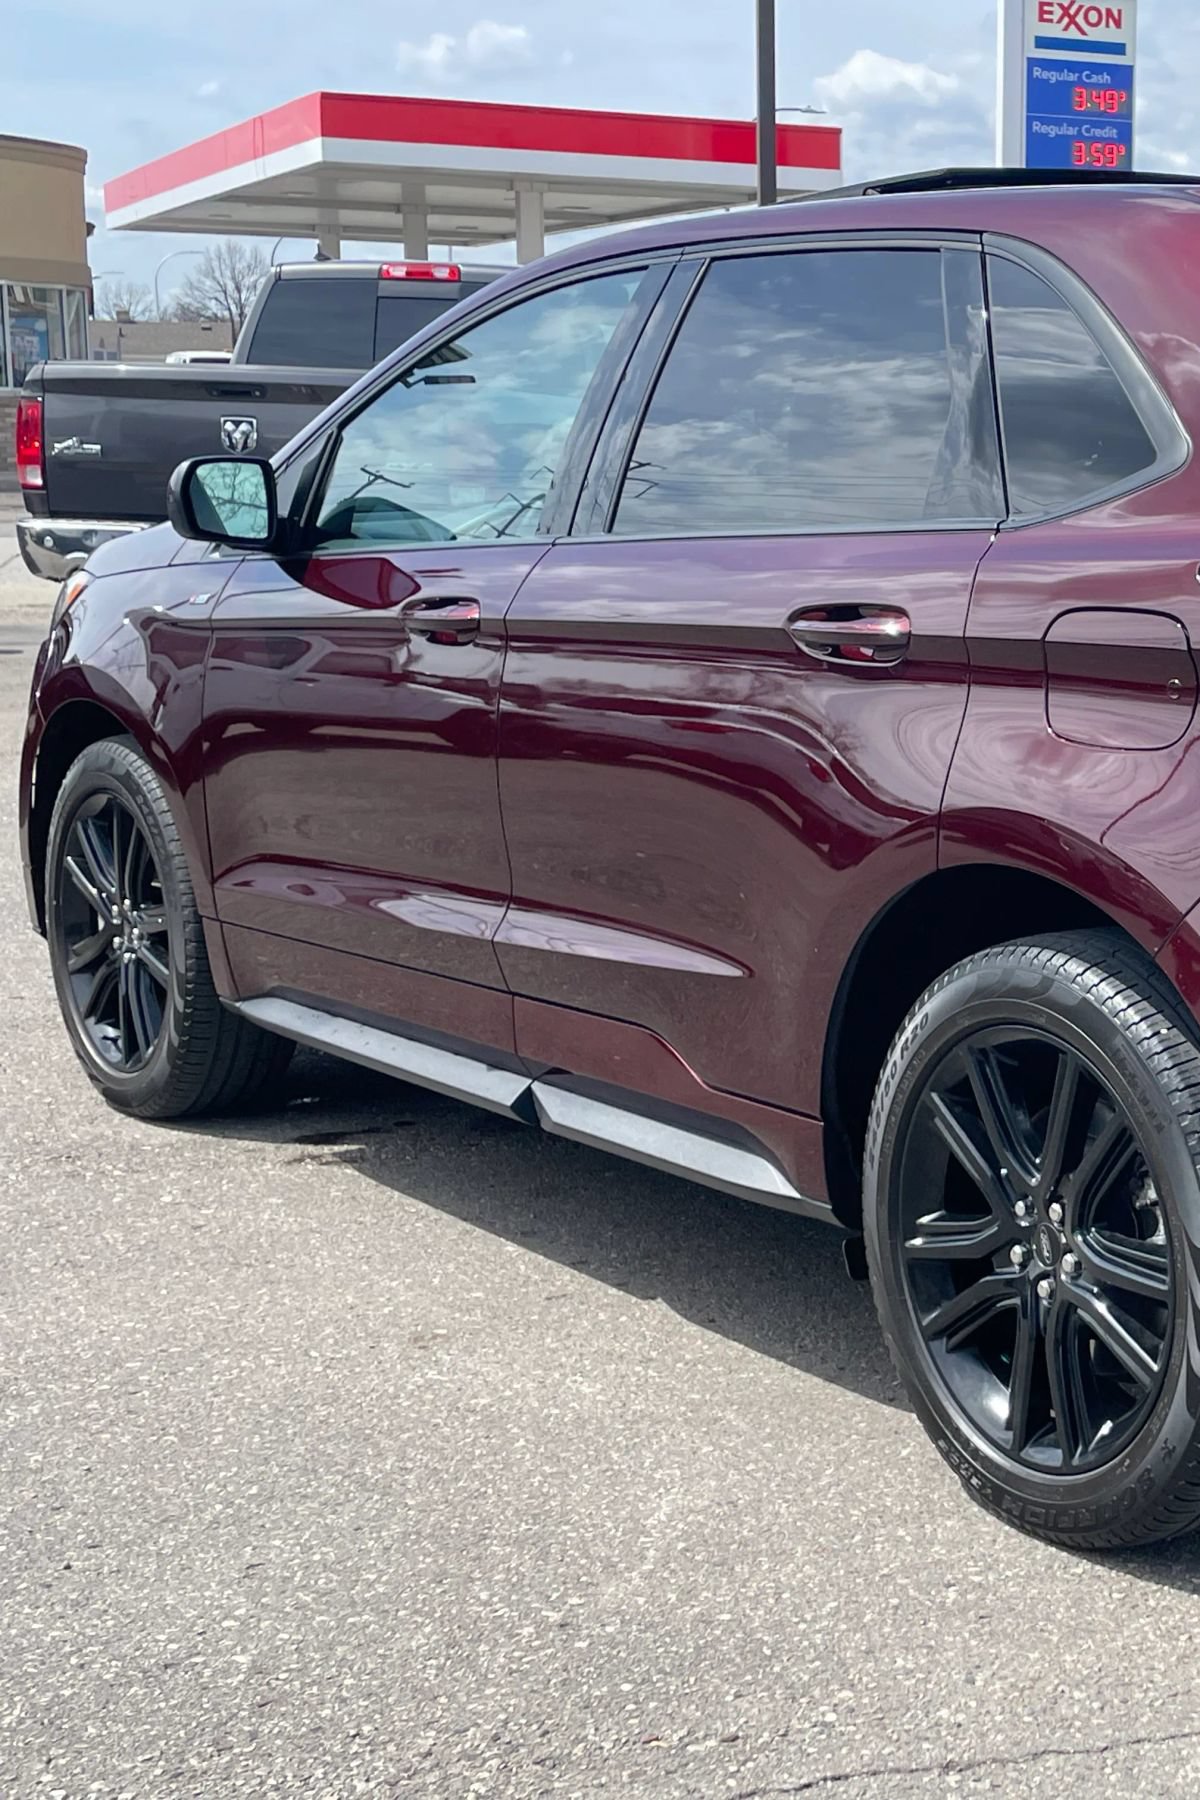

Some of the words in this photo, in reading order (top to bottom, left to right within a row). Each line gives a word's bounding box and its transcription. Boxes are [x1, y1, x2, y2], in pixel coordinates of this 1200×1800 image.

[1037, 0, 1123, 36] EXXON
[1032, 67, 1080, 83] Regular
[1082, 70, 1111, 84] Cash
[1032, 121, 1079, 136] Regular
[1081, 125, 1118, 139] Credit
